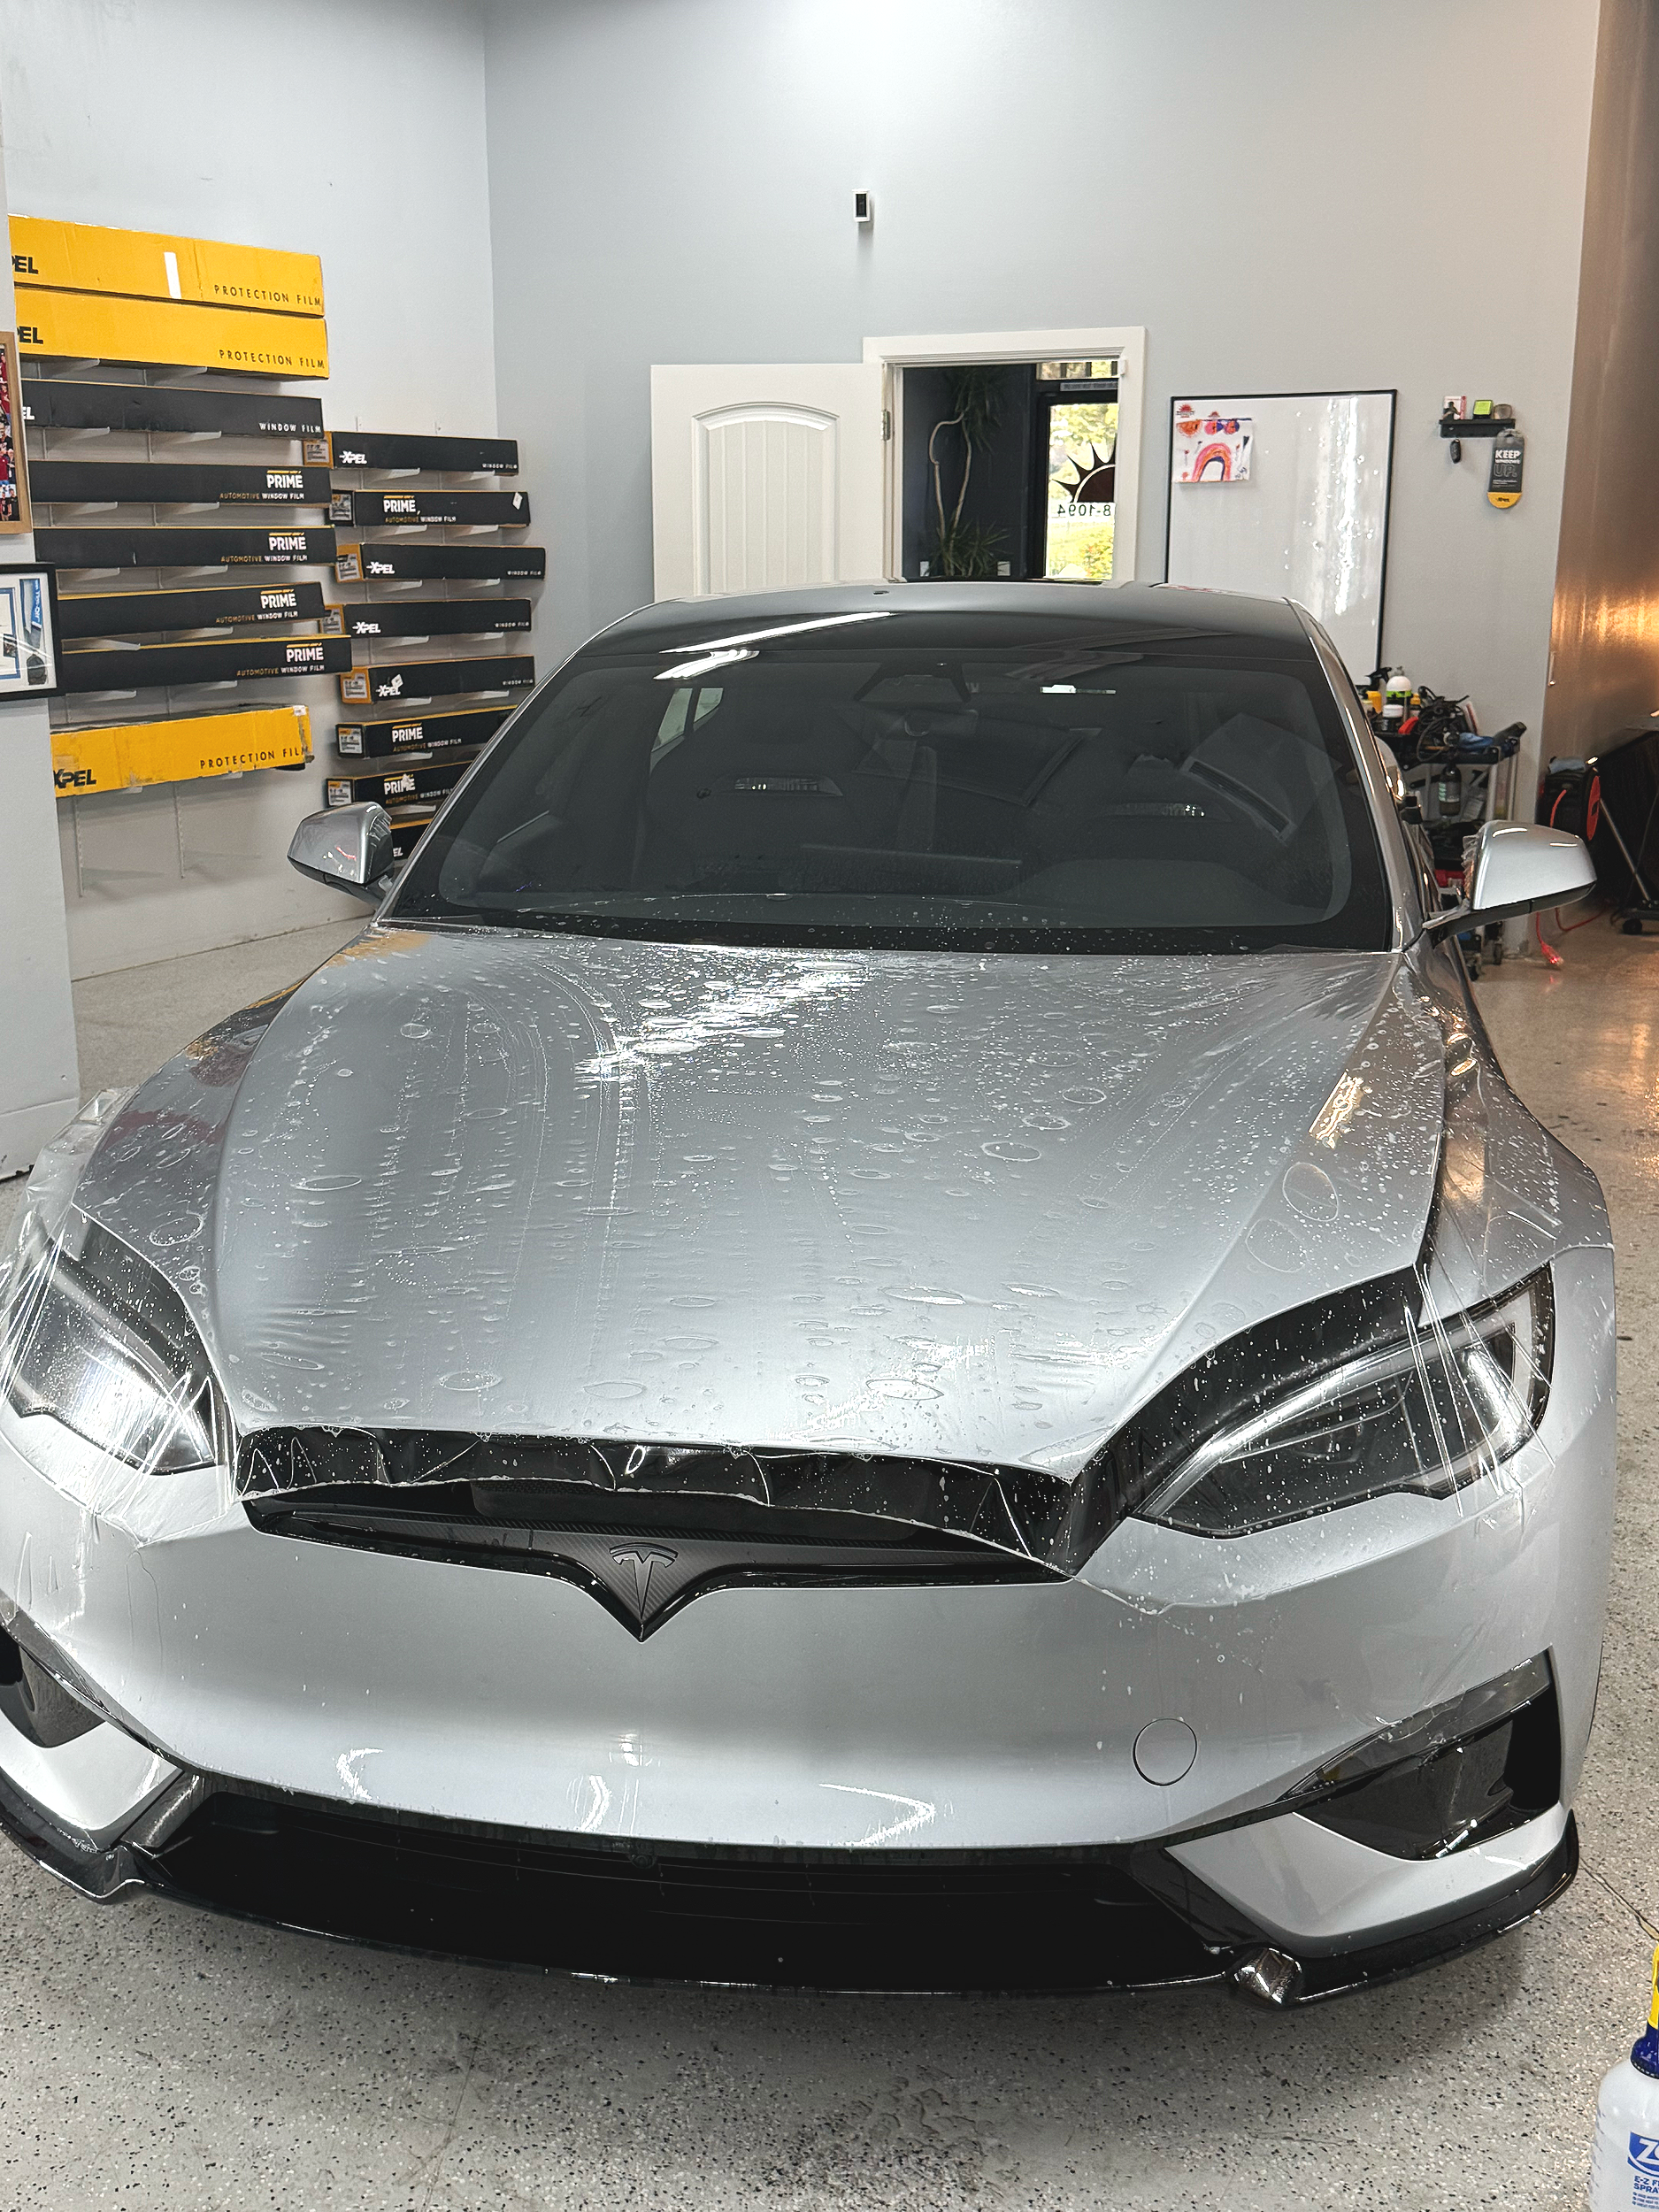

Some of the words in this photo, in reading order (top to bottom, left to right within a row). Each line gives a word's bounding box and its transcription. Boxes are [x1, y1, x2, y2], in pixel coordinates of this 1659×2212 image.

[12, 255, 38, 274] EL
[214, 285, 289, 303] PROTECTION
[296, 295, 320, 305] FILM
[17, 326, 43, 344] EL
[219, 349, 292, 365] PROTECTION
[300, 357, 325, 368] FILM
[259, 422, 296, 432] WINDOW
[301, 424, 321, 434] FILM
[1495, 449, 1521, 458] KEEP
[267, 475, 303, 488] PRIME
[383, 500, 416, 513] PRIME
[269, 537, 306, 550] PRIME
[366, 562, 395, 574] XPEL
[260, 593, 297, 609] PRIME
[352, 622, 380, 634] XPEL
[286, 648, 324, 663] PRIME
[392, 727, 423, 742] PRIME
[200, 750, 275, 769] PROTECTION
[384, 779, 416, 795] PRIME
[1634, 2175, 1650, 2185] E-Z
[1634, 2183, 1659, 2193] SPRA
